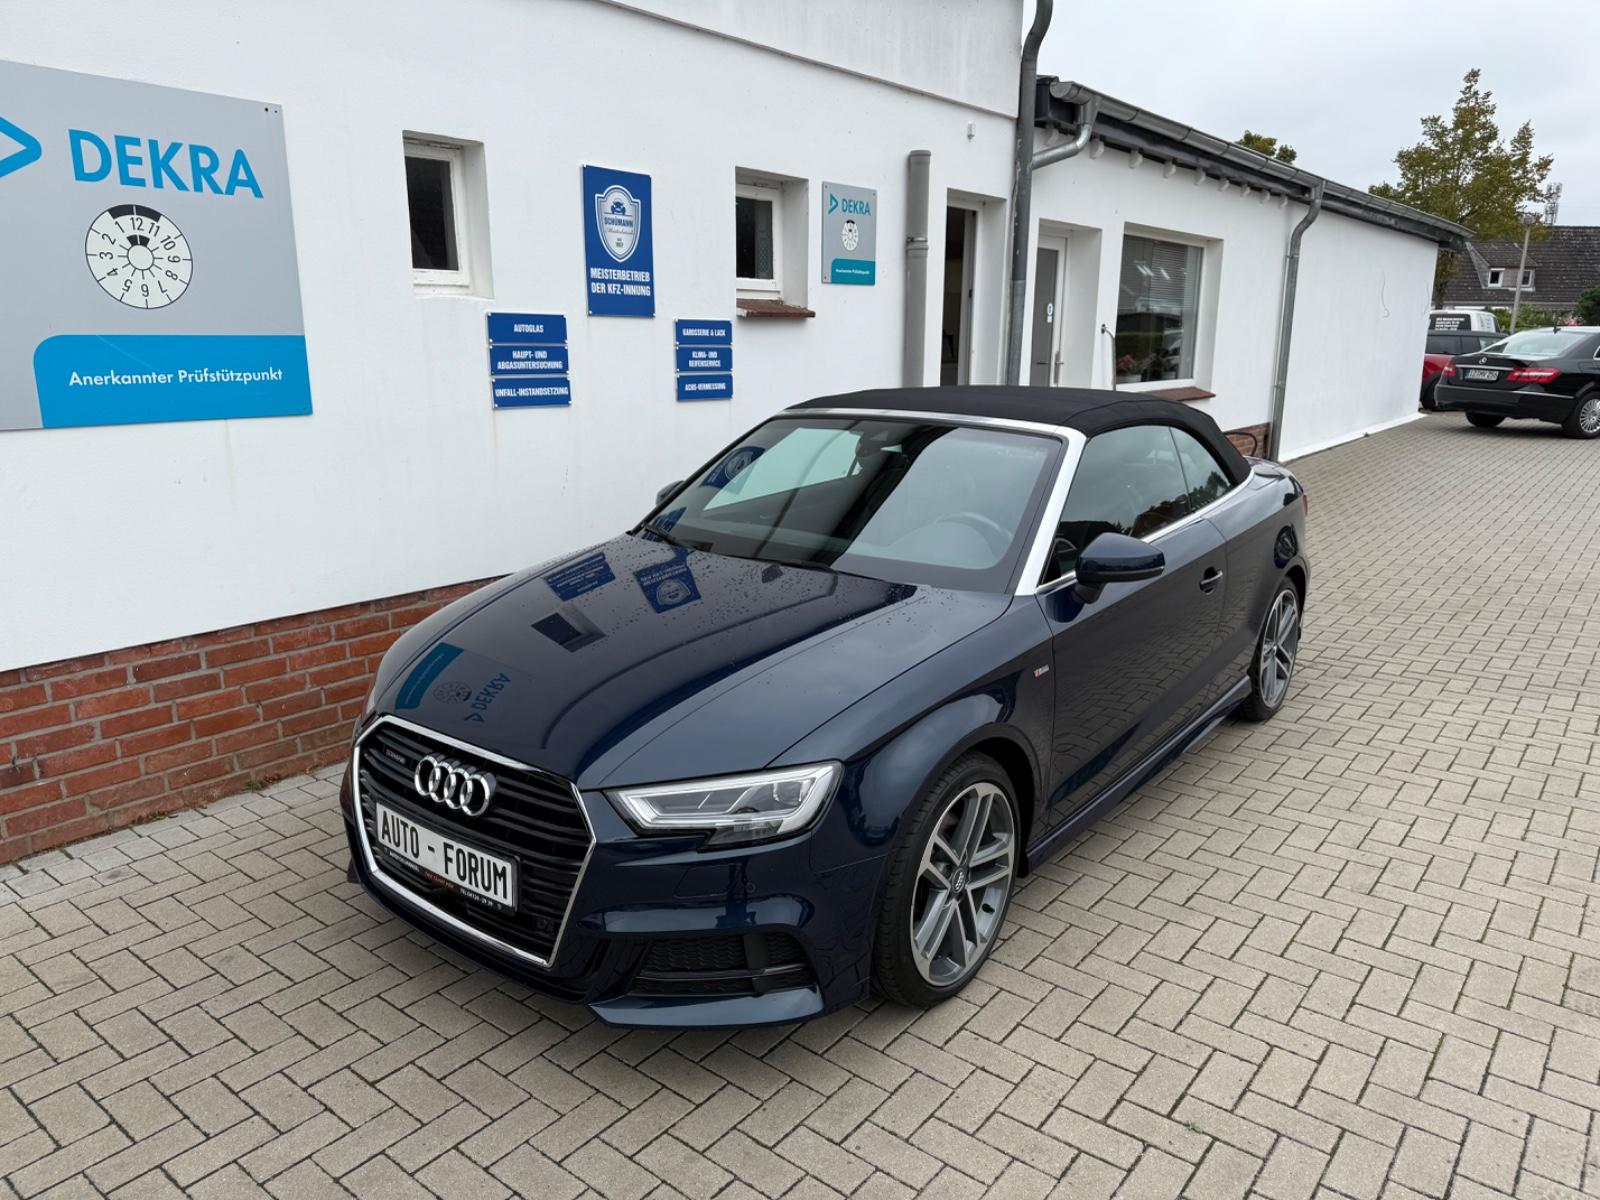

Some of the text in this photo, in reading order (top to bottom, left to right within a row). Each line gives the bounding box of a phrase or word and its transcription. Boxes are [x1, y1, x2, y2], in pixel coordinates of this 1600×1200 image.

[68, 128, 264, 199] DEKRA
[841, 197, 872, 216] DEKRA
[114, 220, 125, 233] 1
[130, 216, 145, 231] 12
[148, 222, 161, 237] 11
[101, 233, 117, 245] 2
[160, 235, 176, 251] 10
[99, 251, 114, 260] 3
[167, 255, 181, 263] 9
[106, 268, 118, 276] 4
[165, 269, 179, 281] 8
[590, 267, 650, 282] MEISTERBETRIEB
[121, 279, 133, 292] 5
[140, 283, 150, 298] 6
[157, 280, 168, 294] 7
[591, 282, 651, 296] DER KFZ-INNUNG
[513, 323, 544, 333] AUTOGLAS
[512, 350, 548, 359] HAUPT- UND
[497, 360, 563, 370] ABGASUNTERSUCHUNG
[69, 366, 283, 386] Anerkannter Prüfstützpunkt
[495, 386, 569, 397] UNFALL-INSTANDSETZUNG
[381, 810, 420, 859] AUTO
[443, 841, 507, 900] FORUM
